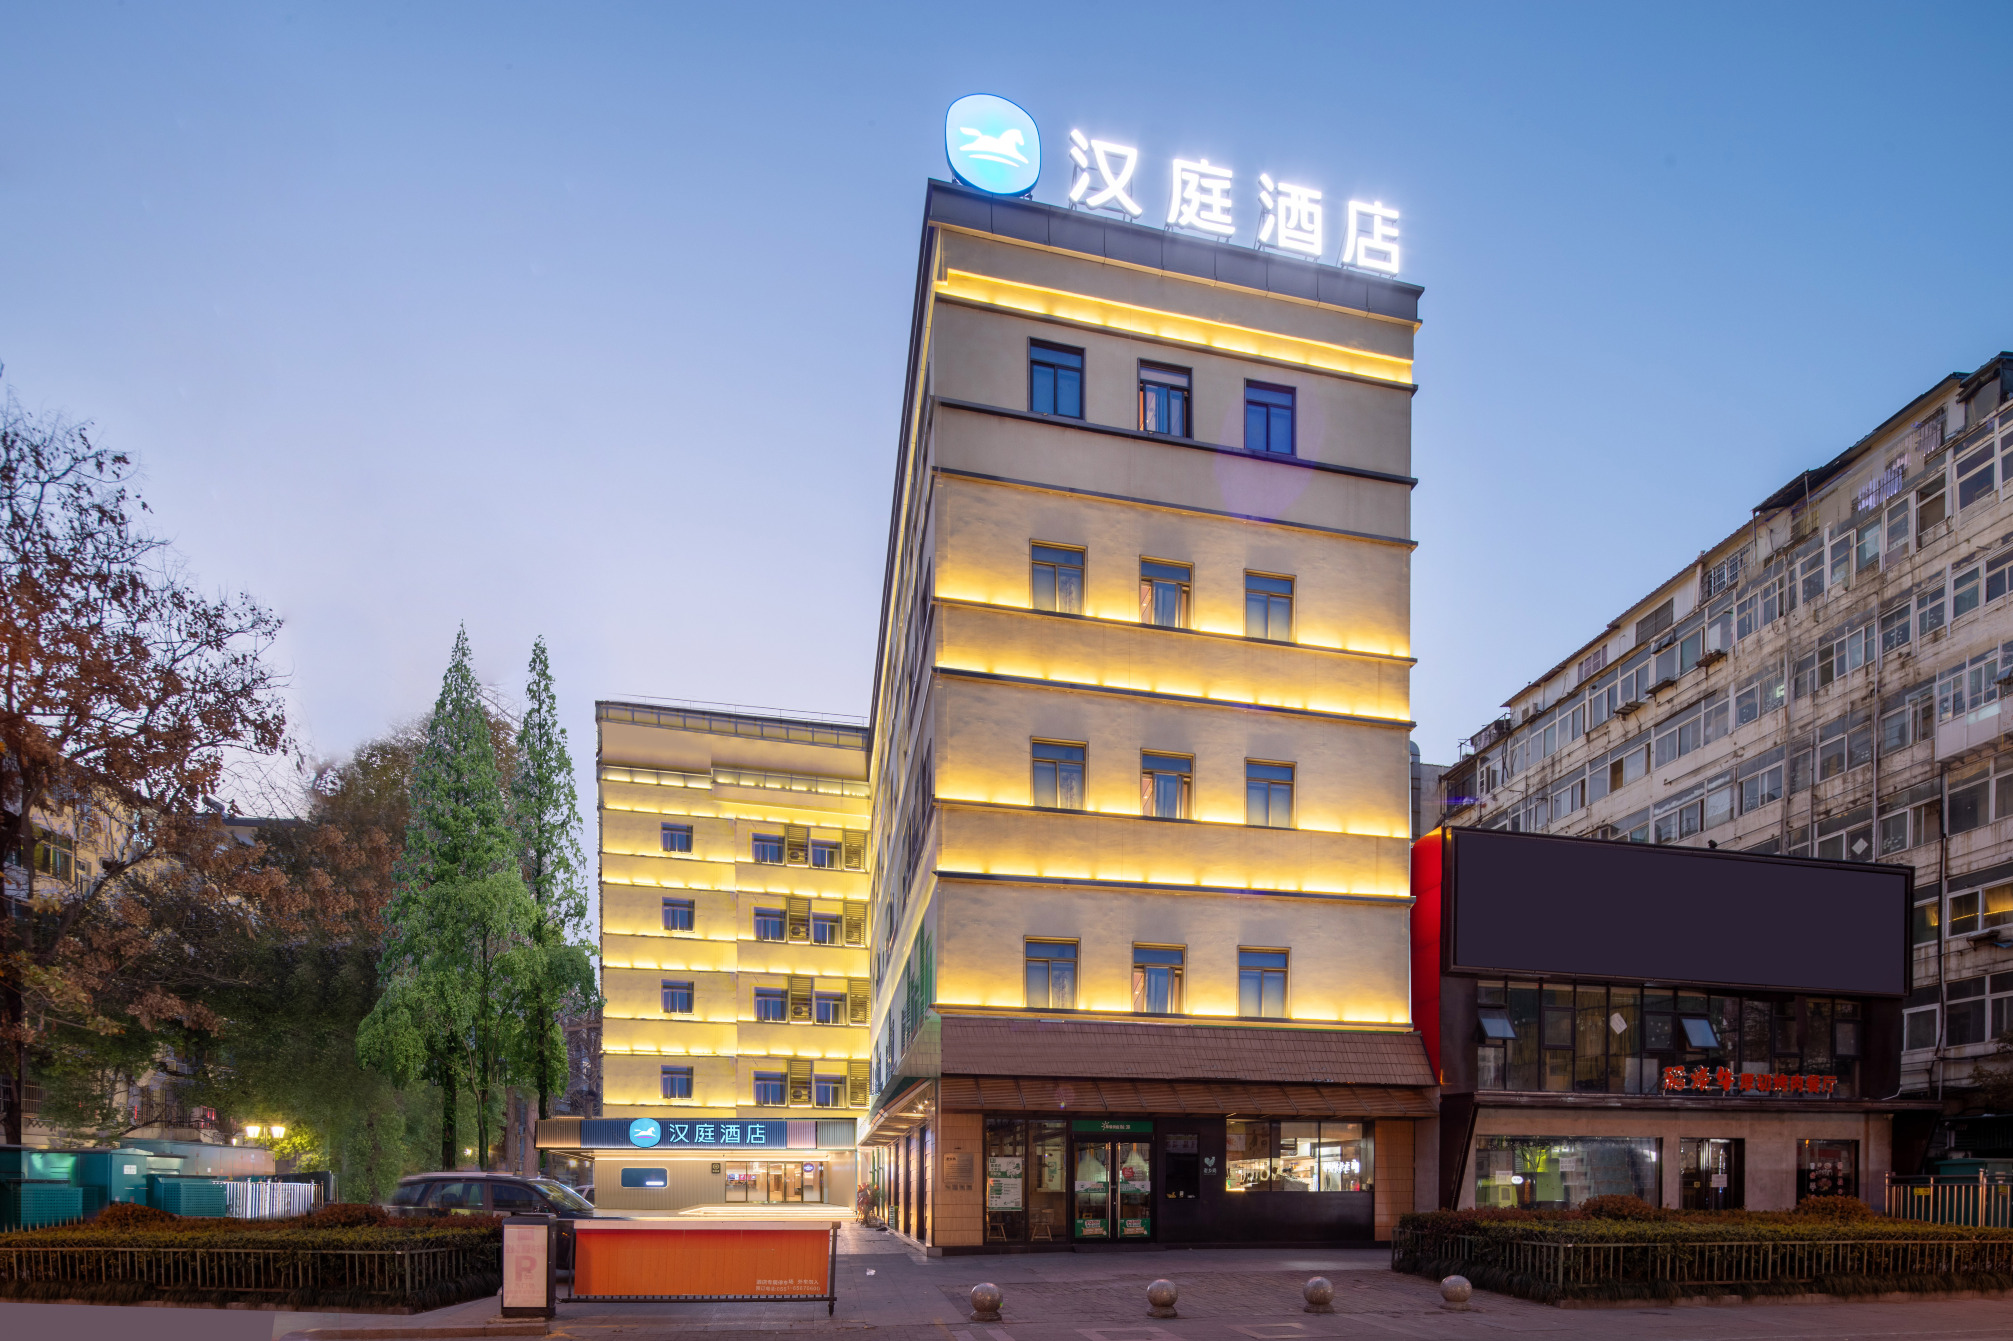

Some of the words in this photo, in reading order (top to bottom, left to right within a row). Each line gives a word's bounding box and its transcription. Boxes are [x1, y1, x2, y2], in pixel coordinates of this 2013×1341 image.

[1068, 128, 1400, 276] 汉庭酒店
[669, 1123, 766, 1144] 汉庭酒店
